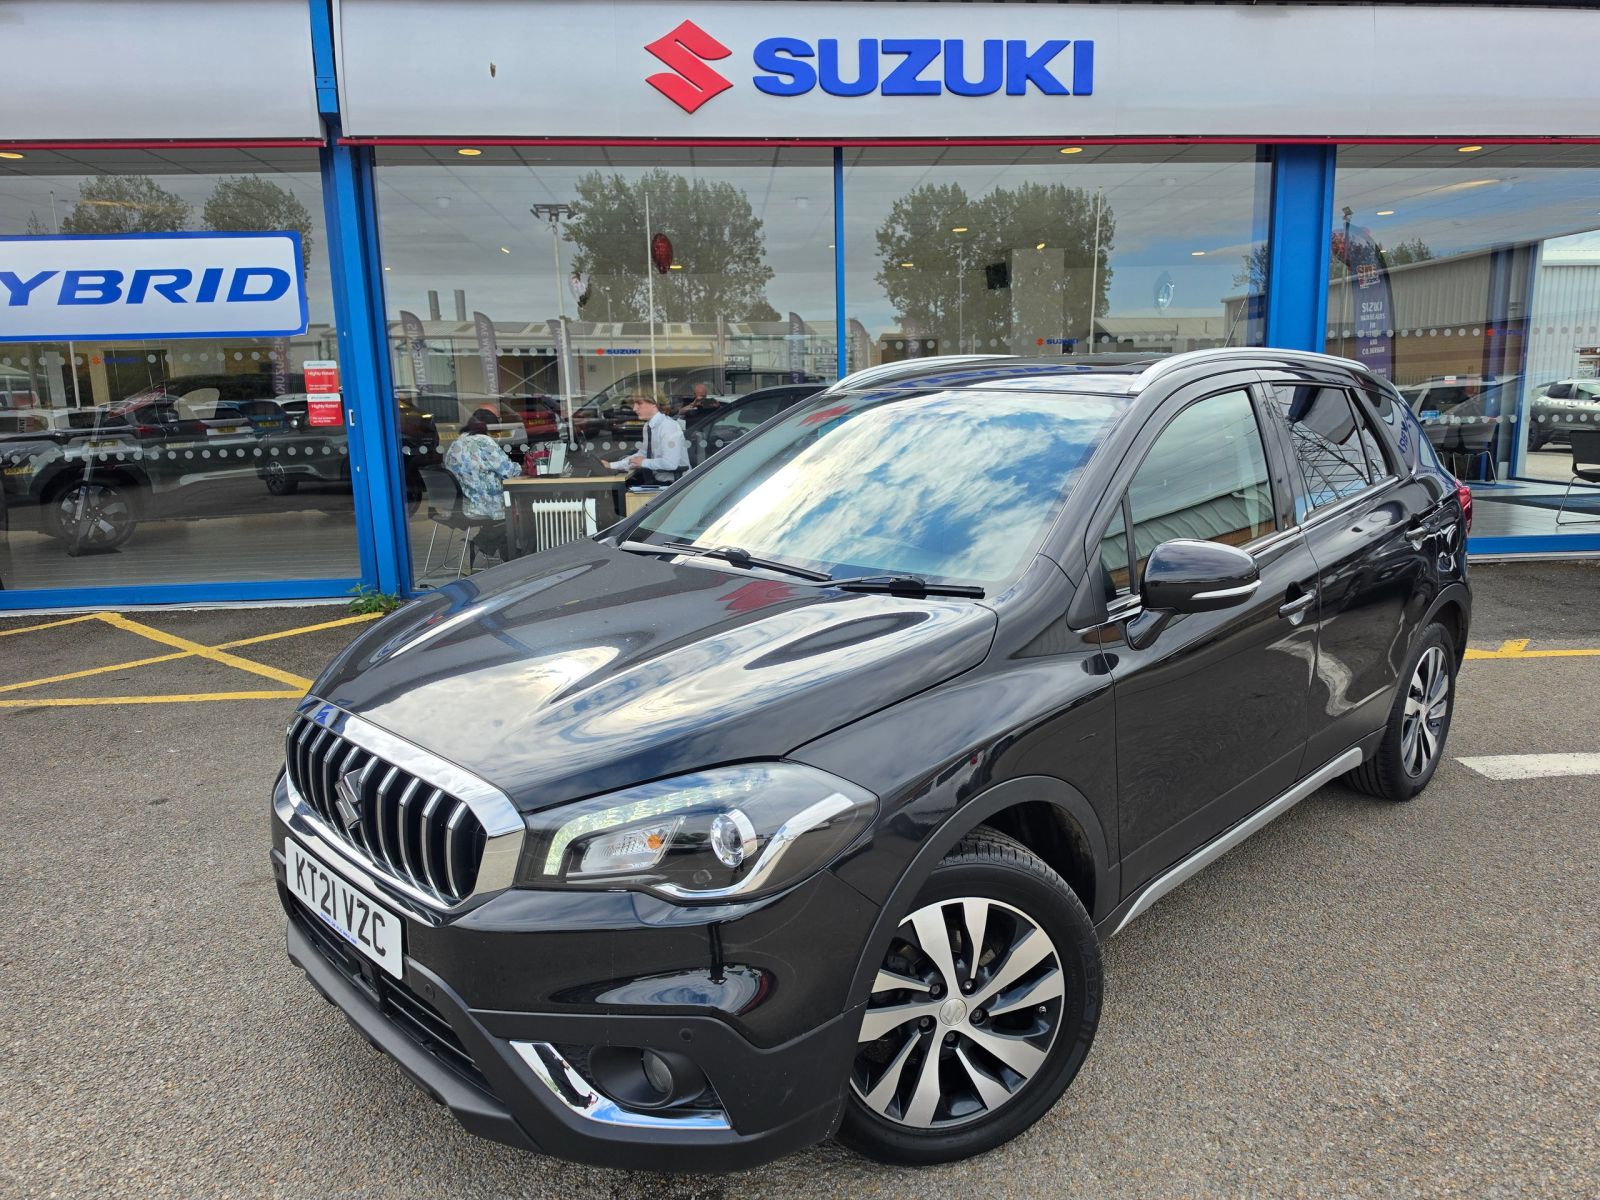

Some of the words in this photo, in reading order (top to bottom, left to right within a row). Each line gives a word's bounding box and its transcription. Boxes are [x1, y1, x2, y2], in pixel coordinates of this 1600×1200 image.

[753, 37, 1094, 97] SUZUKI
[0, 267, 291, 306] YBRID
[295, 851, 337, 921] KT21
[342, 887, 386, 957] VZC
